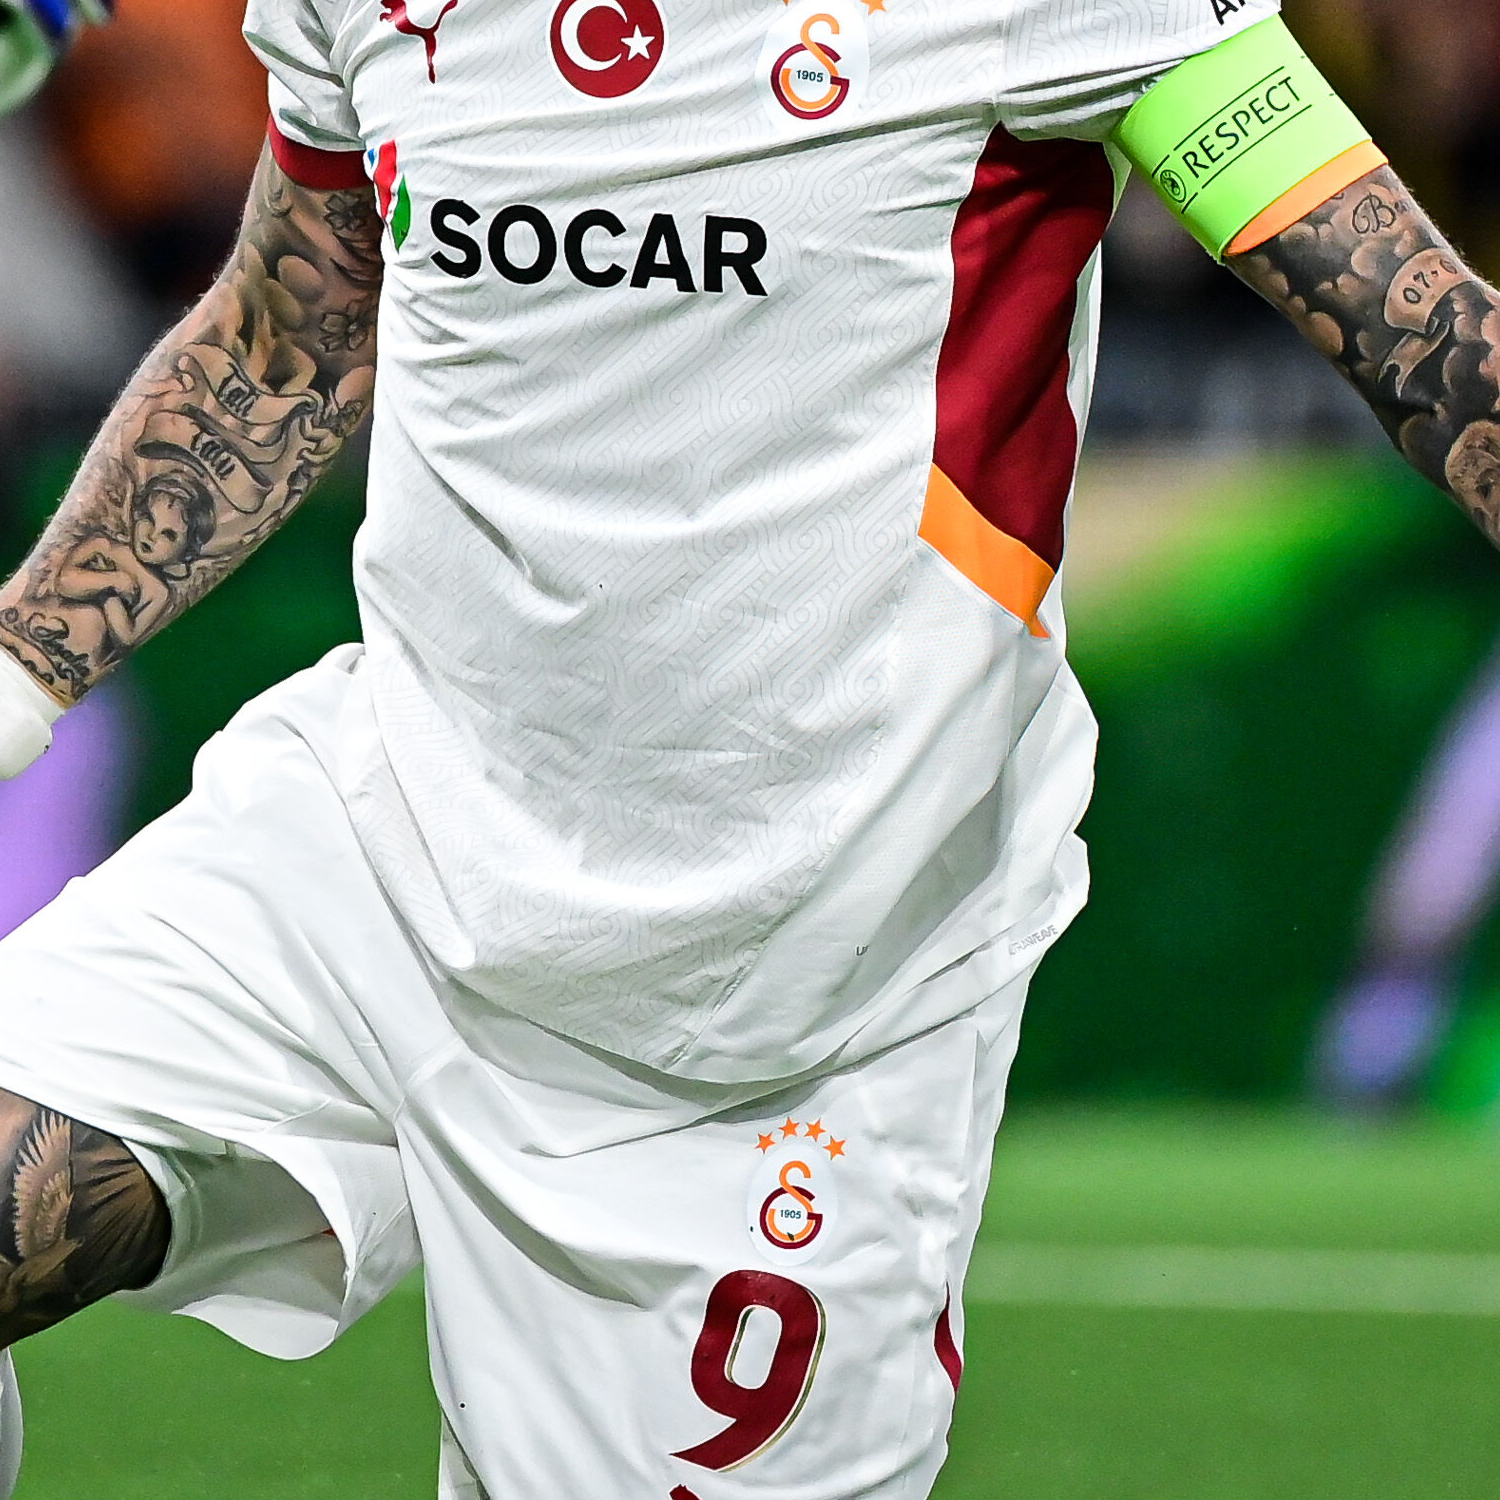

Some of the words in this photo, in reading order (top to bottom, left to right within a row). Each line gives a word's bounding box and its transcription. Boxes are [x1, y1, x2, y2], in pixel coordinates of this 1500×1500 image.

[796, 69, 824, 83] 1905
[1182, 76, 1300, 179] RESPECT
[430, 198, 768, 297] SOCAR
[780, 1209, 802, 1220] 1905
[668, 1269, 827, 1473] 9
